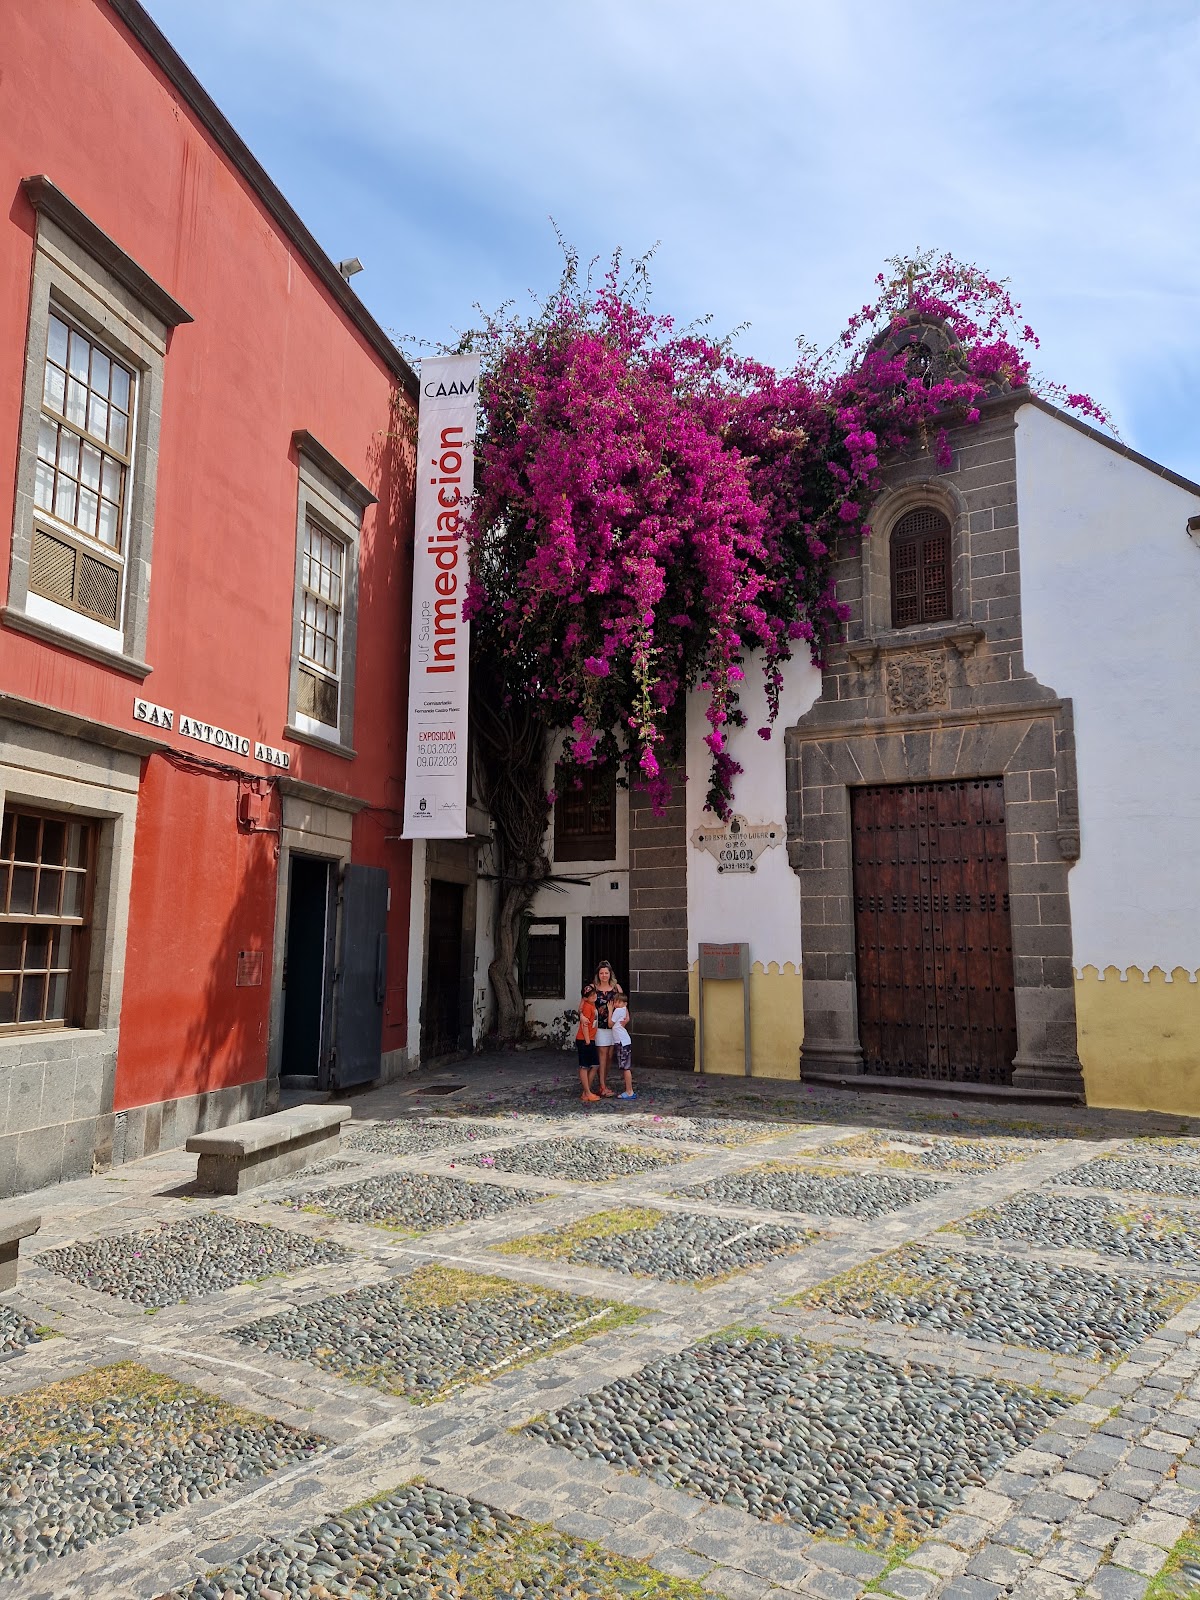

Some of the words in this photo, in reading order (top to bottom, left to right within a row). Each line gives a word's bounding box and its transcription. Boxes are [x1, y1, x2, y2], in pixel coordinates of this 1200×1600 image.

[424, 379, 475, 398] CAAM
[426, 426, 464, 673] Inmediación
[418, 600, 432, 642] Saupe
[418, 644, 430, 663] Ulf
[136, 702, 173, 729] SAN
[180, 718, 250, 755] ANTONIO
[255, 745, 289, 767] ABAD
[418, 729, 456, 742] EXPOSICIÓN
[417, 743, 457, 755] 16.03.2023
[416, 755, 458, 768] 09.07.2023
[719, 849, 753, 861] COLON
